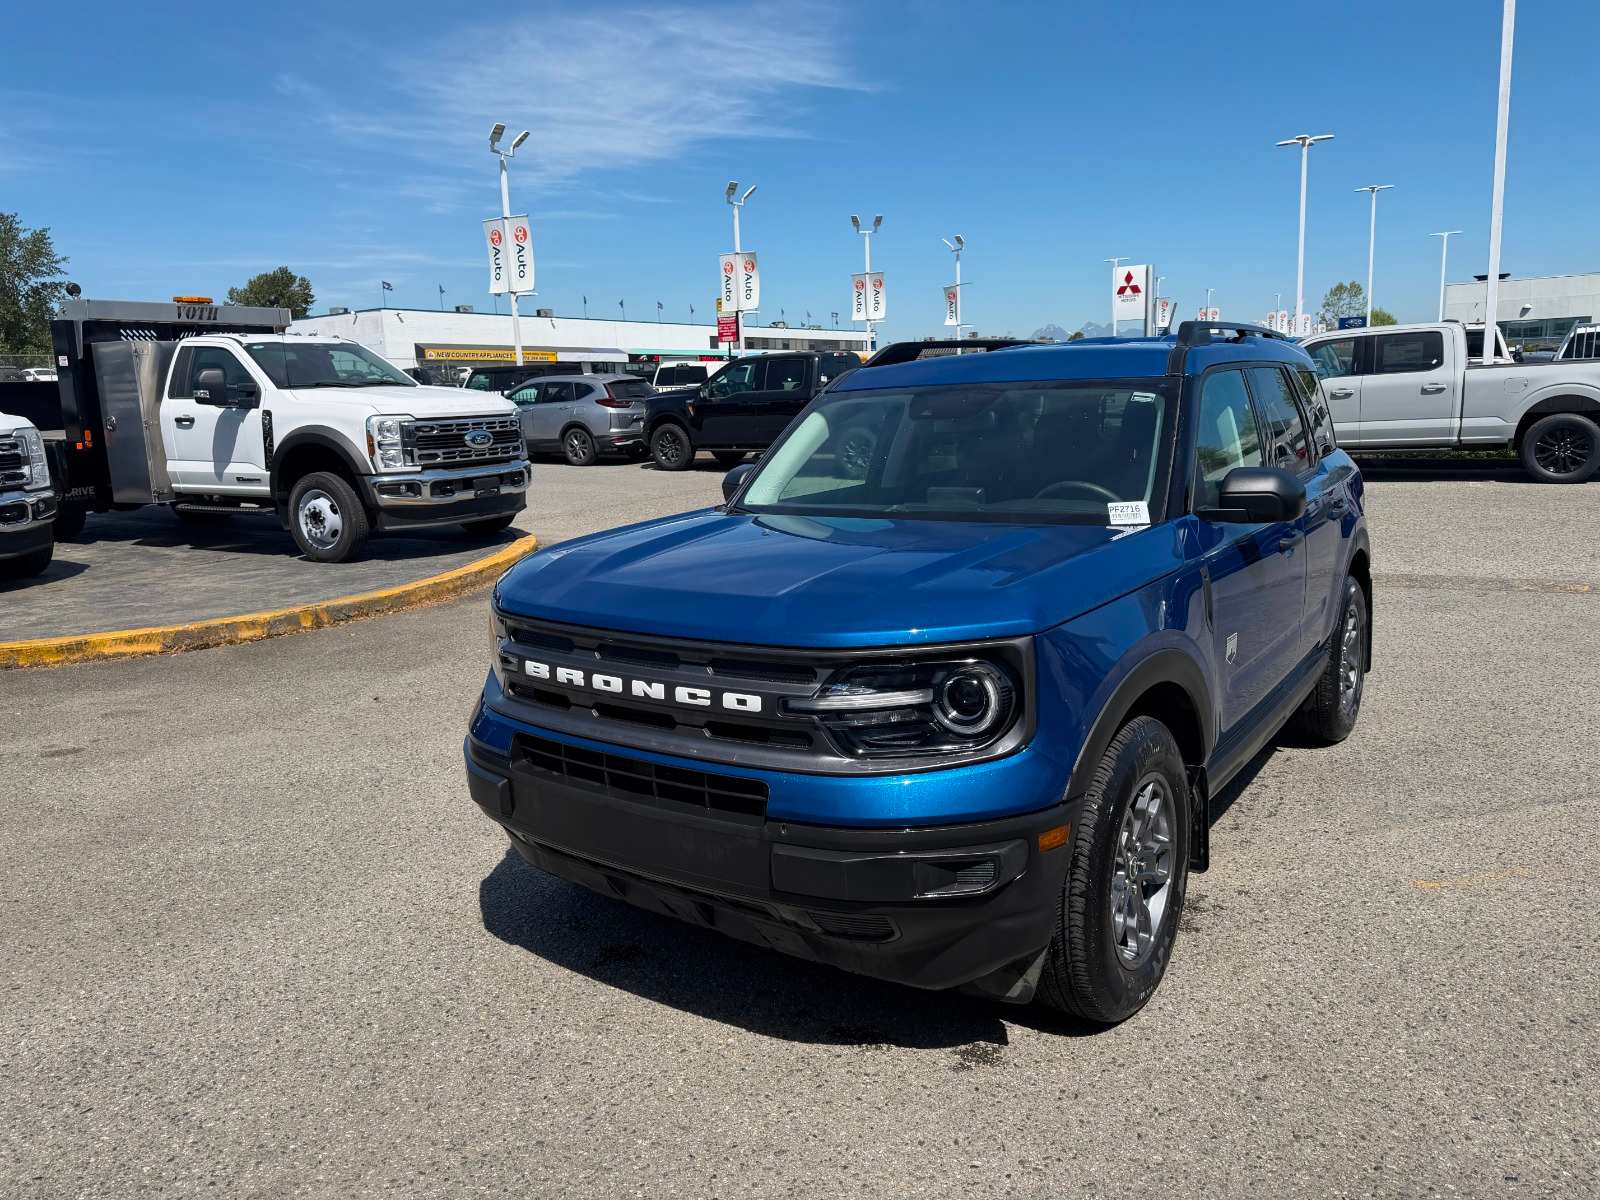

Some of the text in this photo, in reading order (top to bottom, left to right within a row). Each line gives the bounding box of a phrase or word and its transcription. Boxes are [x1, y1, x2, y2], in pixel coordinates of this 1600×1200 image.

[493, 246, 502, 280] Auto
[516, 244, 526, 279] Auto
[724, 274, 733, 302] Auto
[744, 273, 753, 300] Auto
[176, 305, 218, 320] VOTH
[524, 660, 762, 712] BRONCO
